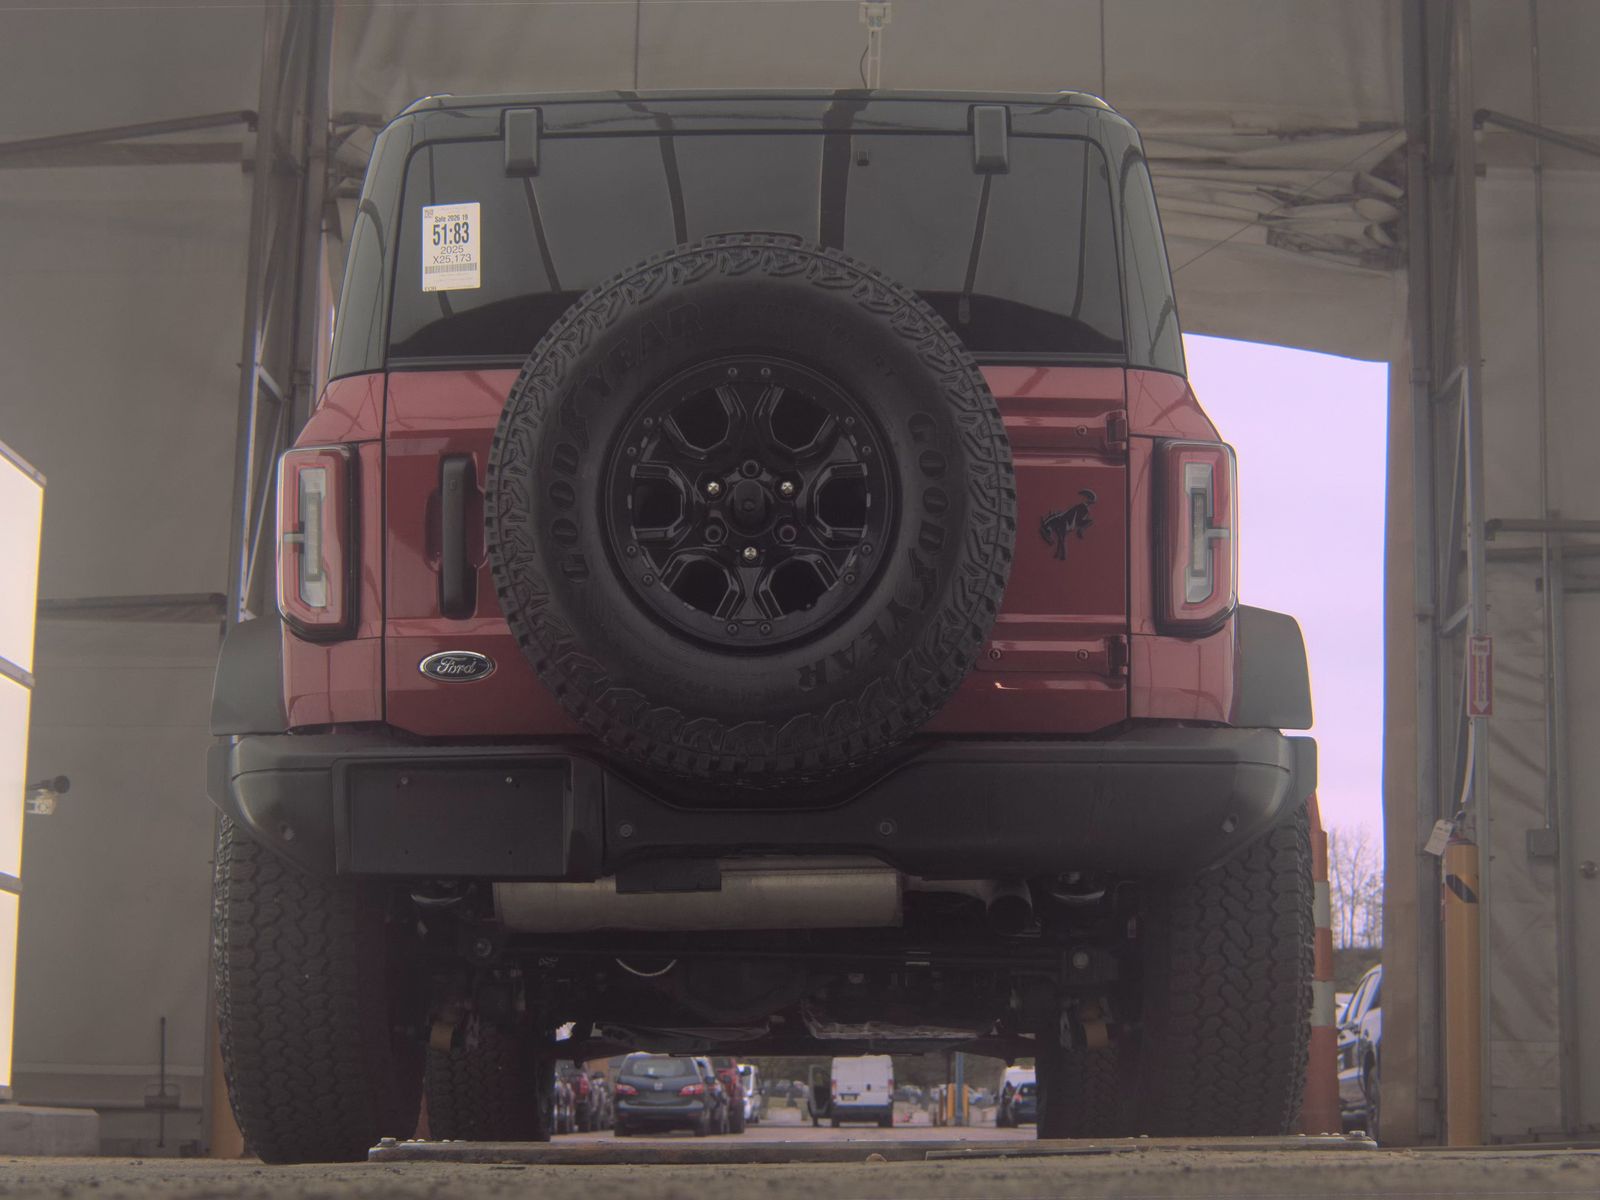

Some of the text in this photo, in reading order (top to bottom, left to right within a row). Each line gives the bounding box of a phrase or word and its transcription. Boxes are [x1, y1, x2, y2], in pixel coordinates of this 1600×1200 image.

[433, 222, 470, 246] 51:83
[440, 246, 464, 255] 2025
[433, 254, 472, 265] X25,173
[437, 657, 478, 674] Ford
